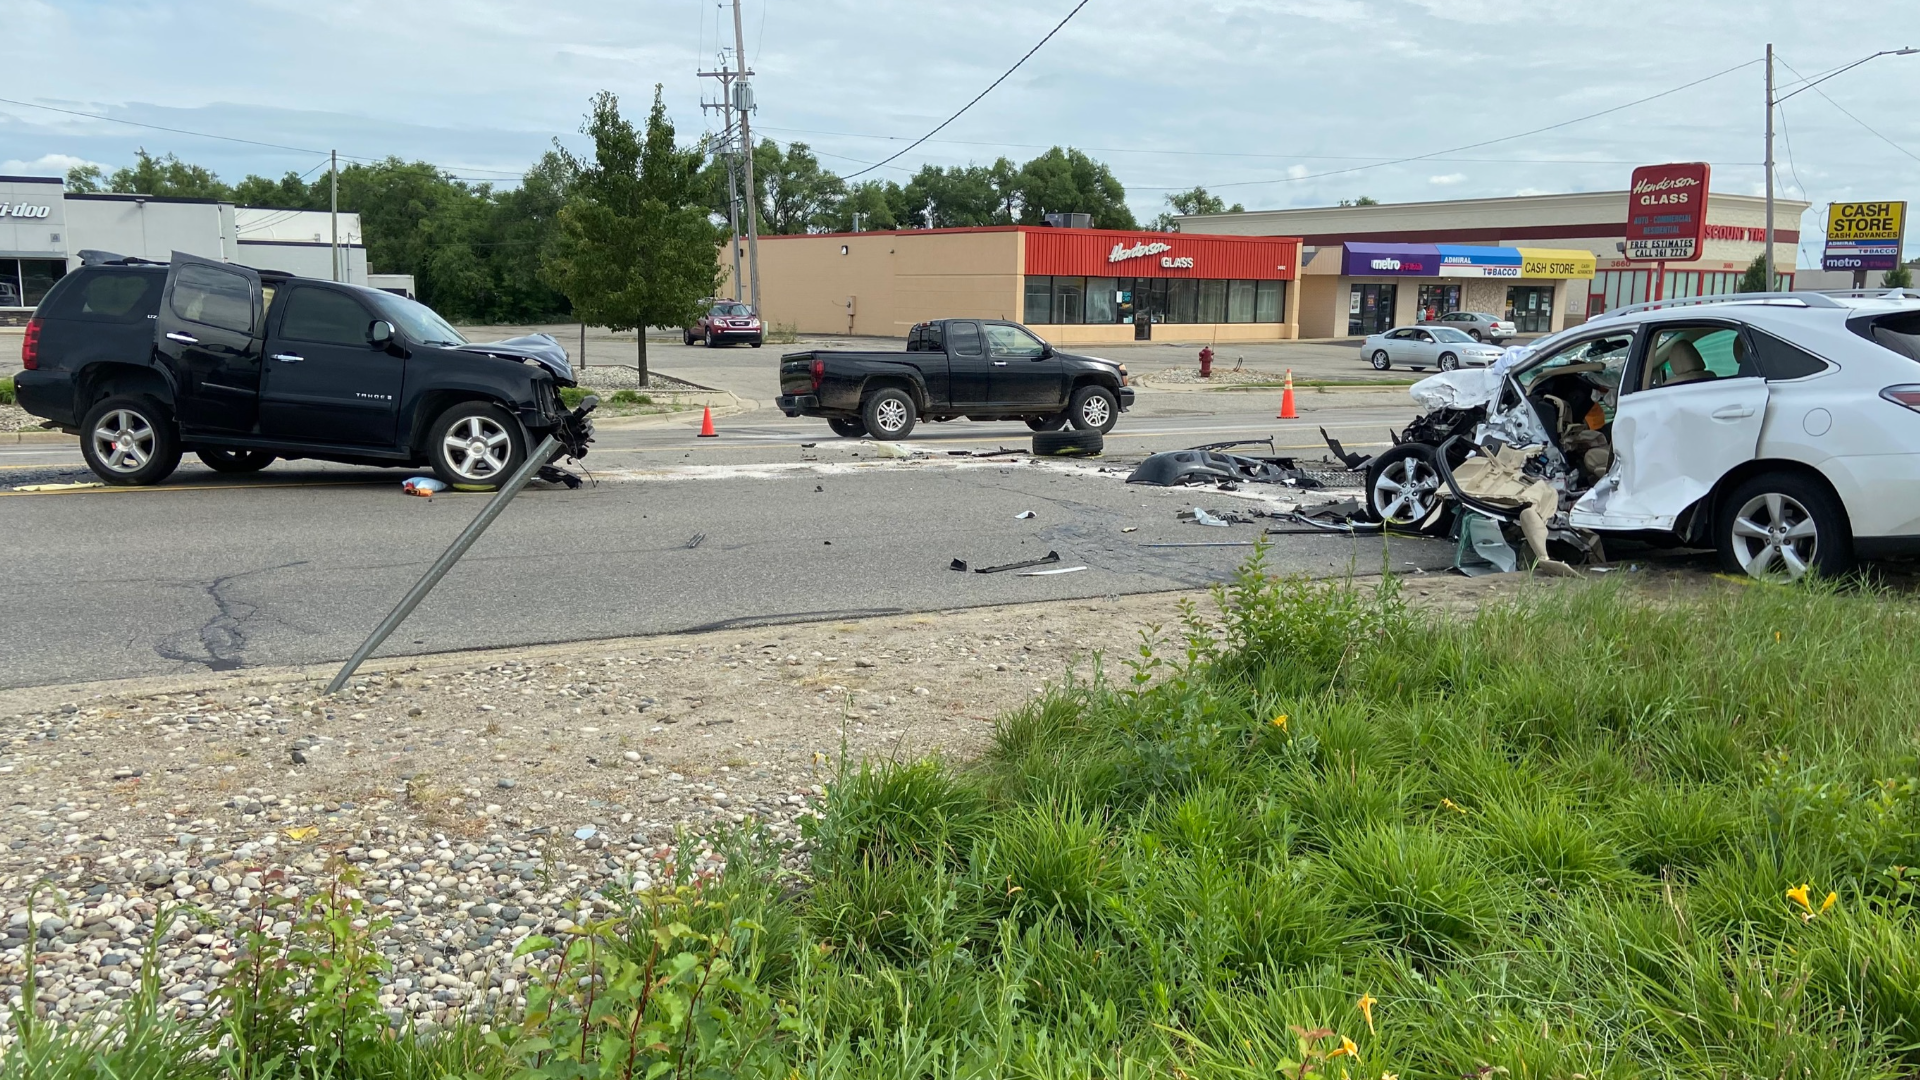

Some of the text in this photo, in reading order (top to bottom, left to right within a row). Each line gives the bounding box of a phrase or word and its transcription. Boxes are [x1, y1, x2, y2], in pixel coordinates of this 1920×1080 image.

[1633, 177, 1700, 194] Henderson
[1640, 193, 1688, 205] GLASS
[0, 201, 50, 218] i-doo
[1841, 203, 1890, 218] CASH
[1834, 217, 1893, 232] STORE
[1705, 224, 1767, 242] SCOUNT TIR
[1852, 231, 1898, 239] ADVANCES
[1630, 239, 1693, 249] FREE ESTIMATES
[1108, 241, 1172, 263] Henderson
[1635, 249, 1652, 258] CALL
[1654, 249, 1667, 257] 361
[1160, 256, 1194, 269] GLASS
[1370, 257, 1400, 271] metro
[1443, 256, 1472, 264] ADMIRAL
[1826, 256, 1861, 268] metro
[1483, 267, 1518, 277] TOBACCO
[1524, 262, 1575, 275] CASH STORE
